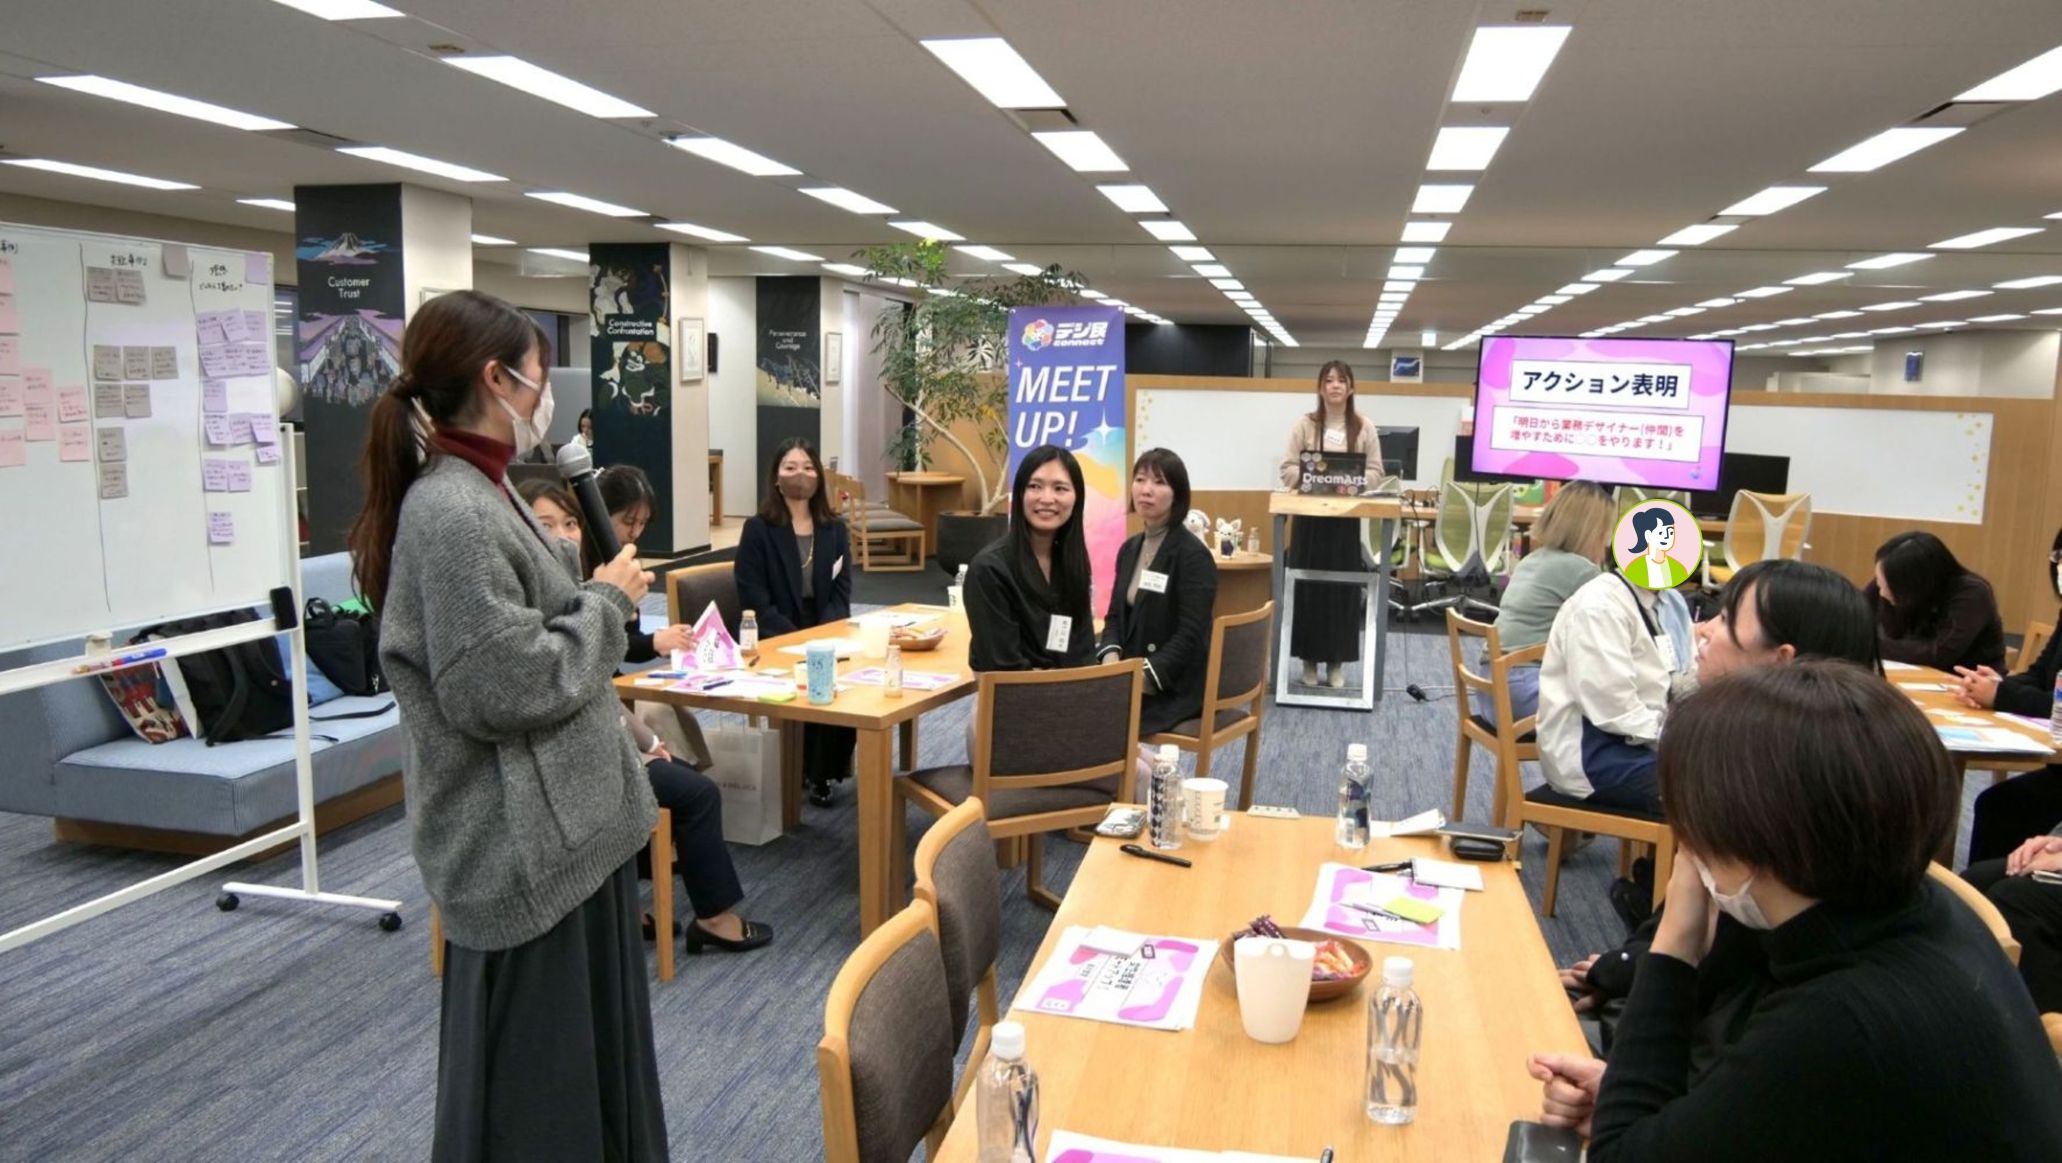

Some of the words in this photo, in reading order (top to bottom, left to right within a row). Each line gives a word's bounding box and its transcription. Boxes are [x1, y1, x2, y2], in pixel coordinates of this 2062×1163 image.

[327, 276, 370, 288] Customer
[338, 288, 360, 299] Trust
[608, 319, 653, 328] Constructive
[606, 326, 655, 336] Confrontation
[1053, 339, 1105, 347] connect
[1016, 365, 1117, 403] MEET
[1523, 370, 1679, 398] アクション表明
[1014, 410, 1079, 448] UP!
[1303, 473, 1369, 486] DreamArts
